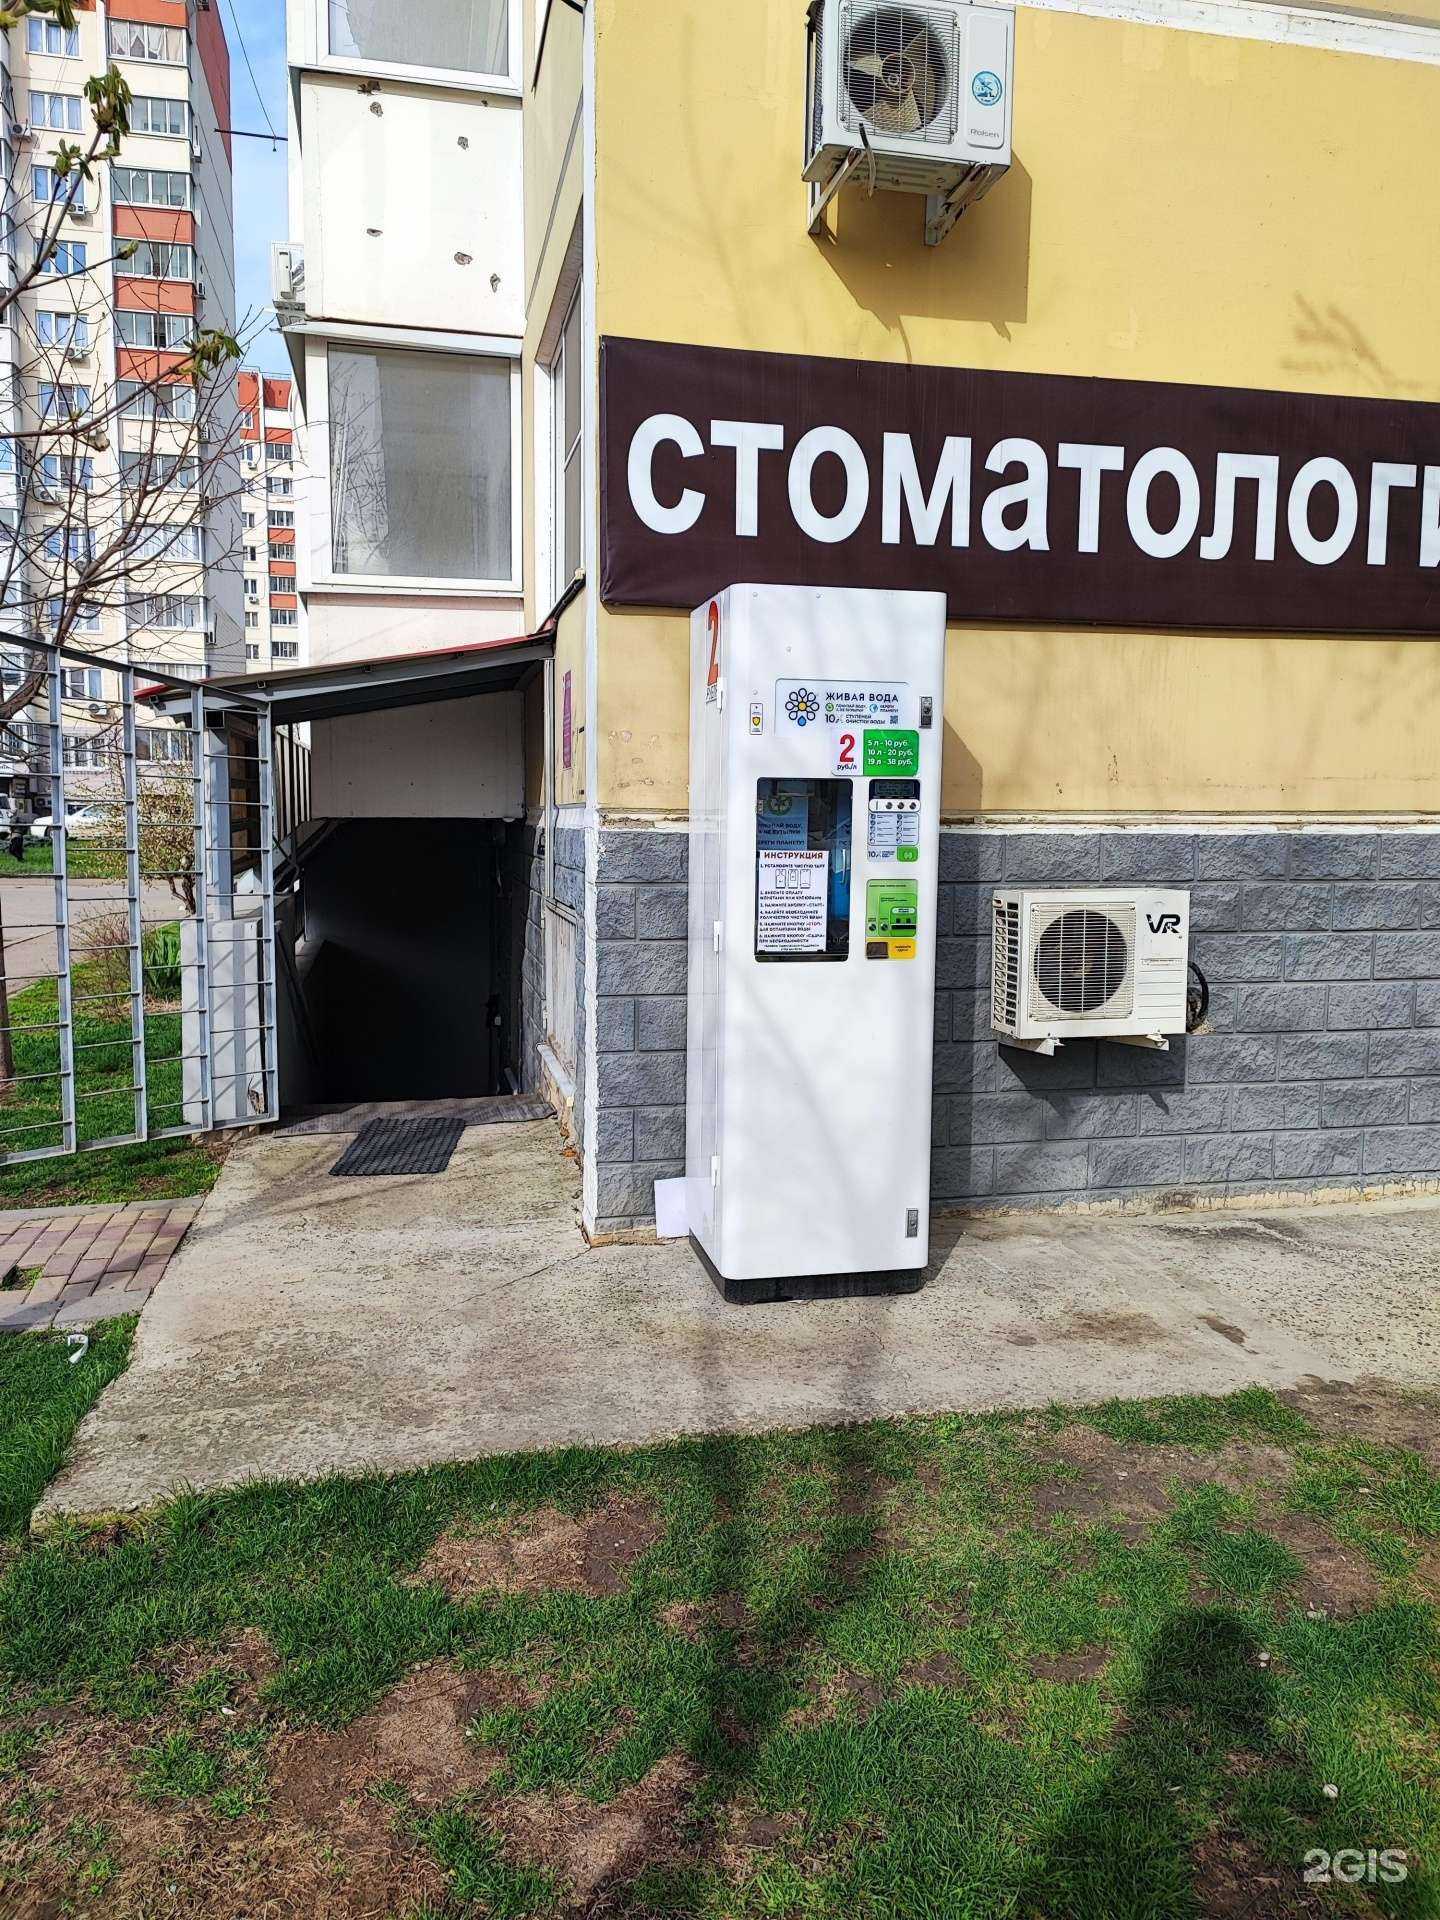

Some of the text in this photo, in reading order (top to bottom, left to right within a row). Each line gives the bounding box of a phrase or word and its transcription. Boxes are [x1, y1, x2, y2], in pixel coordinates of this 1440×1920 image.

[708, 600, 719, 686] 2
[826, 692, 899, 703] ЖИВАЯ ВОДА
[839, 734, 856, 763] 2
[885, 739, 893, 747] 10
[764, 851, 823, 860] ИНСТРУКЦИЯ
[1146, 913, 1181, 934] VR
